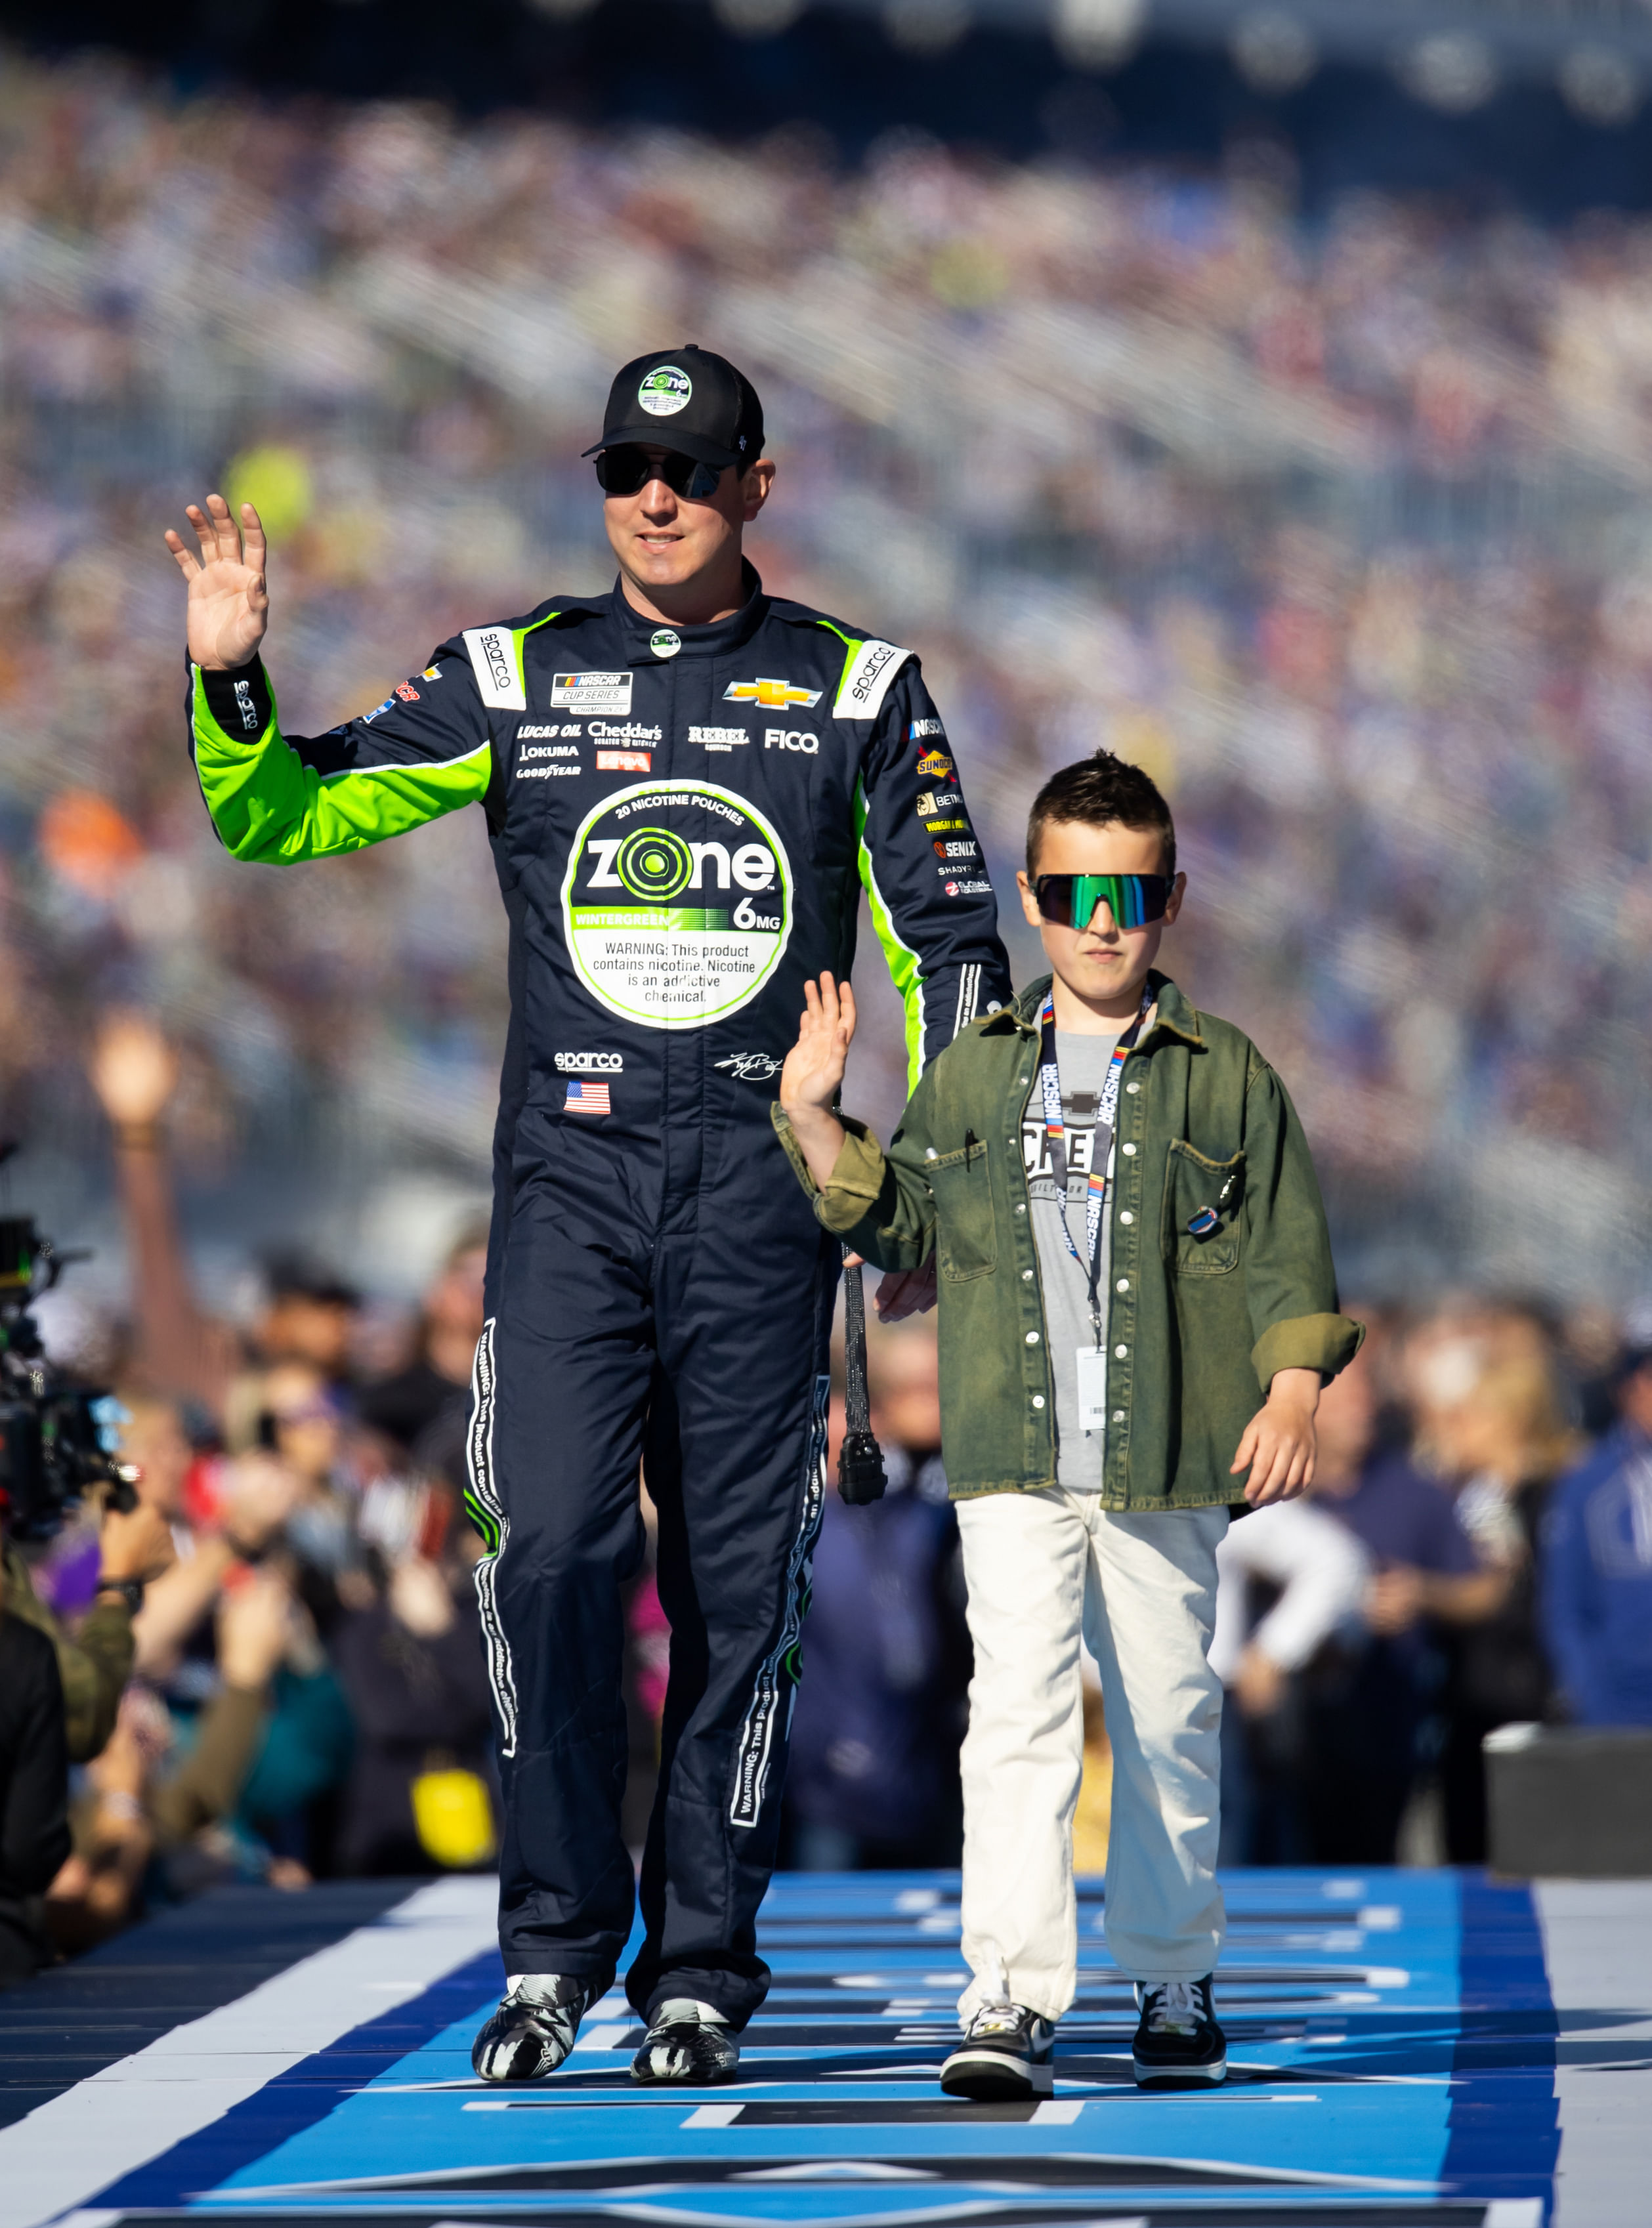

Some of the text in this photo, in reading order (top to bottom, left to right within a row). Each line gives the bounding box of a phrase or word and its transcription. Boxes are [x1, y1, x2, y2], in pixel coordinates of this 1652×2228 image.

[645, 373, 688, 390] zone
[480, 633, 511, 691] sparco
[578, 675, 622, 686] NASCAR
[852, 647, 895, 703] sparco
[234, 680, 259, 730] sparco
[562, 690, 620, 700] CUP SERIES
[517, 724, 582, 739] LUCAS OIL
[587, 721, 662, 741] Cheddar's
[688, 726, 750, 745] REBEL
[764, 728, 819, 753] FICO
[600, 754, 646, 767] Lenovo
[615, 794, 745, 826] 20 NICOTINE POUCHES
[945, 841, 977, 857] SENIX
[586, 827, 776, 901] zone
[576, 914, 669, 926] WINTERGREEN
[605, 942, 749, 958] WARNING: This product
[593, 959, 755, 973] contains nicotine. Nicotine
[628, 975, 720, 987] is an addictive
[645, 990, 707, 1003] chemical.
[554, 1052, 623, 1072] sparco
[1042, 1063, 1063, 1119] NASCAR
[1097, 1063, 1122, 1125] NASCAR
[1086, 1194, 1103, 1261] NASCAR
[475, 1332, 502, 1515] WARNING: This product contains
[811, 1503, 818, 1519] an
[494, 1636, 504, 1690] addictive
[740, 1675, 771, 1814] WARNING: This product
